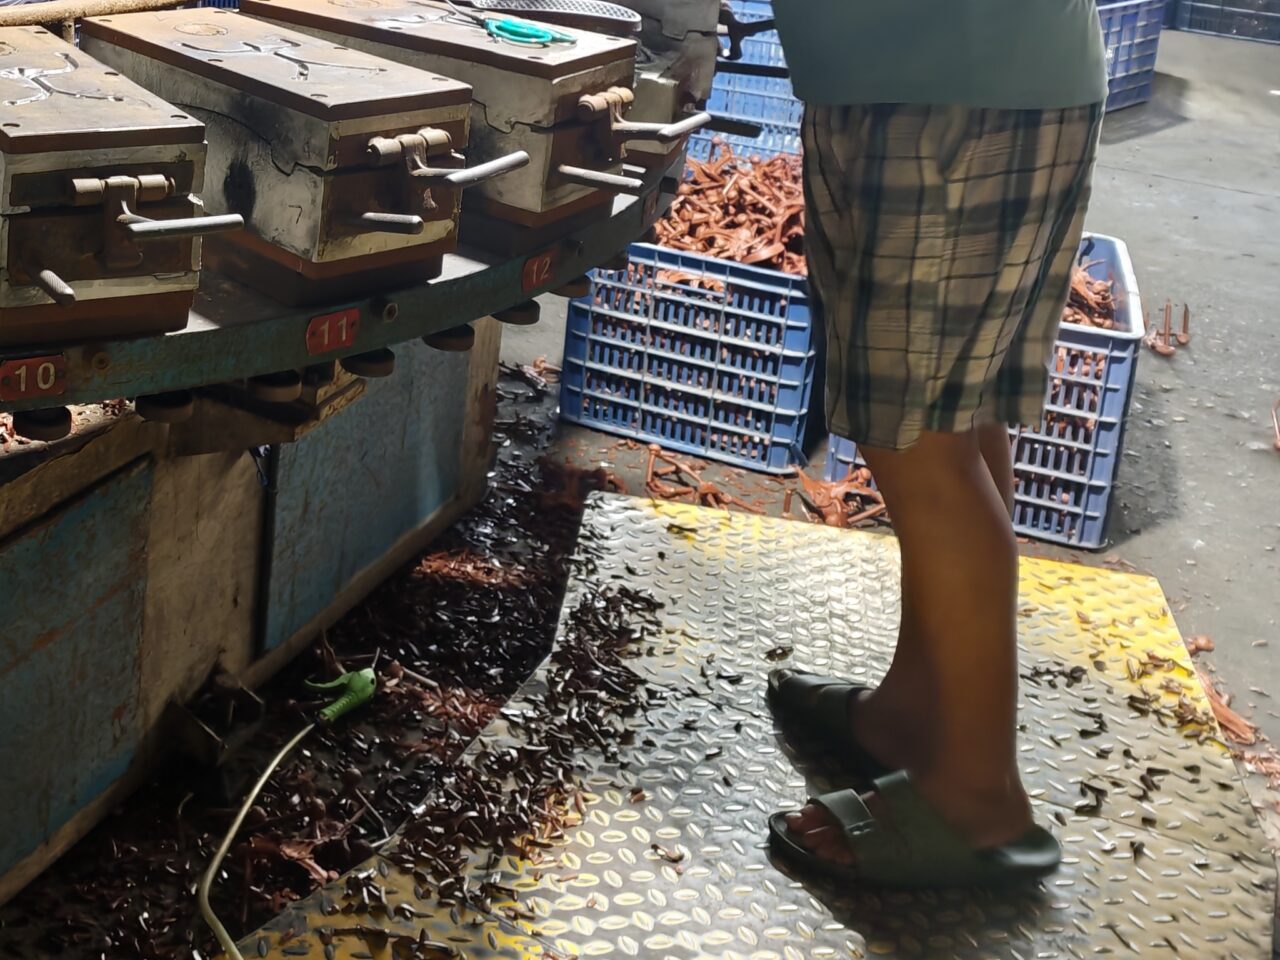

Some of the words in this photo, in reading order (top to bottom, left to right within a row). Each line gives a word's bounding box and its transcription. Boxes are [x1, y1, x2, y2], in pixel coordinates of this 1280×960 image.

[532, 256, 552, 285] 12
[319, 315, 348, 347] 11
[14, 361, 56, 393] 10
